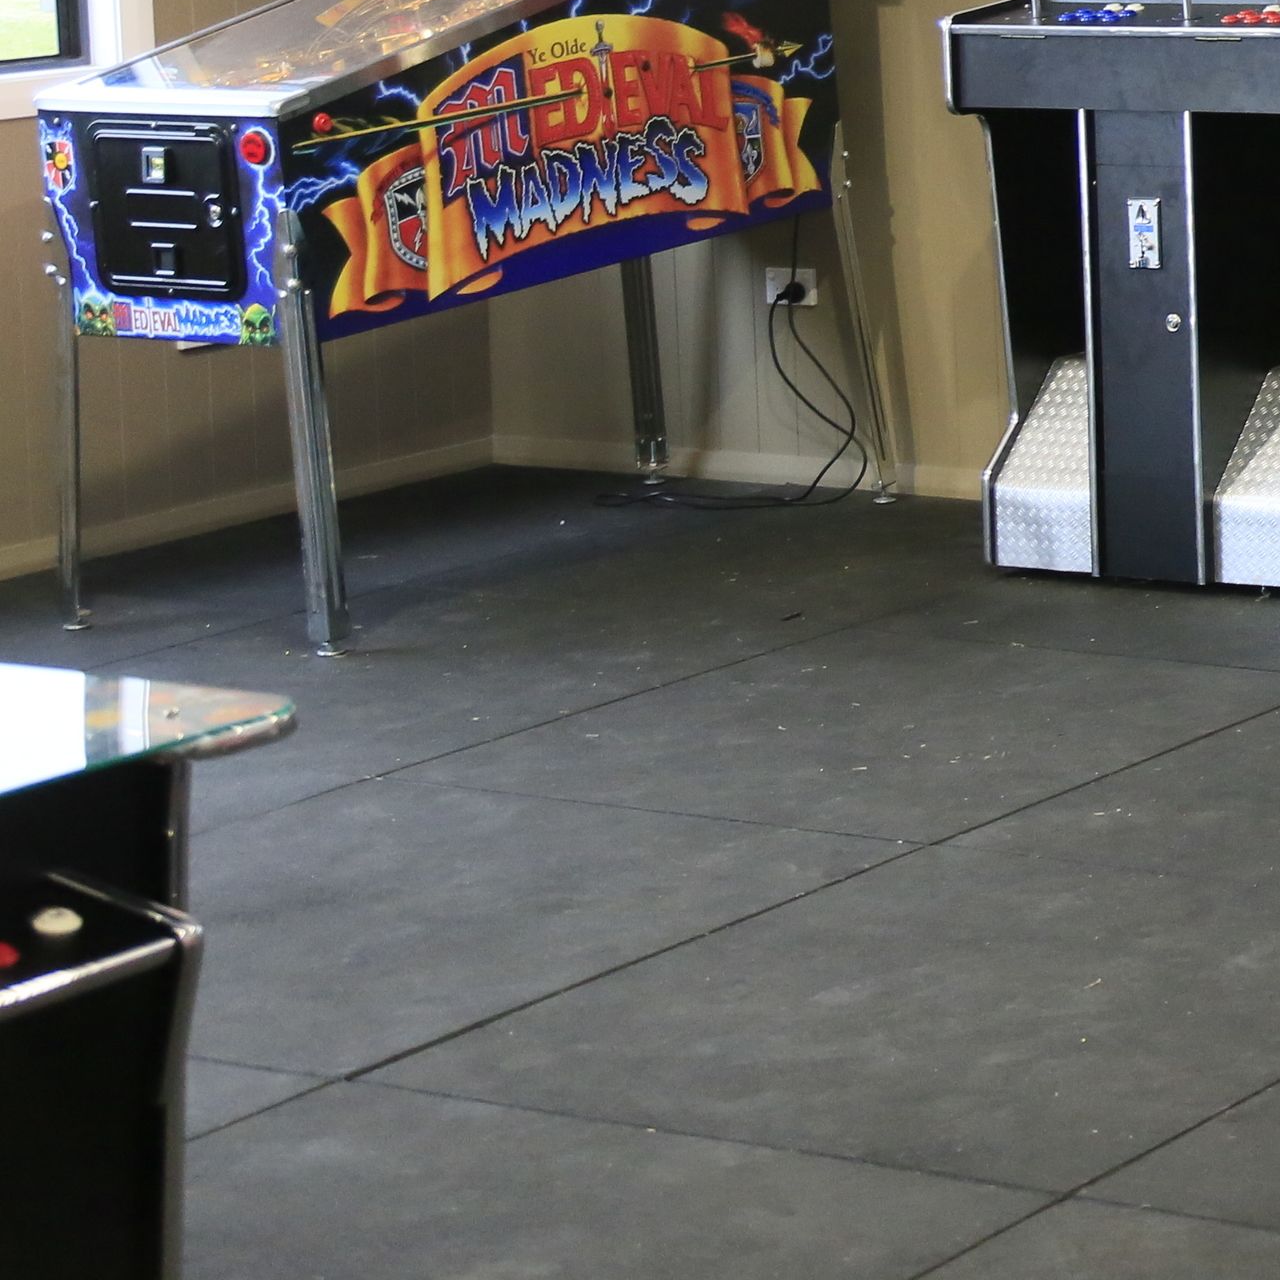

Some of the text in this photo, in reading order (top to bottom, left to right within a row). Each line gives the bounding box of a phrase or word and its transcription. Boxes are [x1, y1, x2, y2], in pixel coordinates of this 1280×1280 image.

[528, 38, 588, 65] Ye Olde
[466, 116, 709, 262] MADNESS
